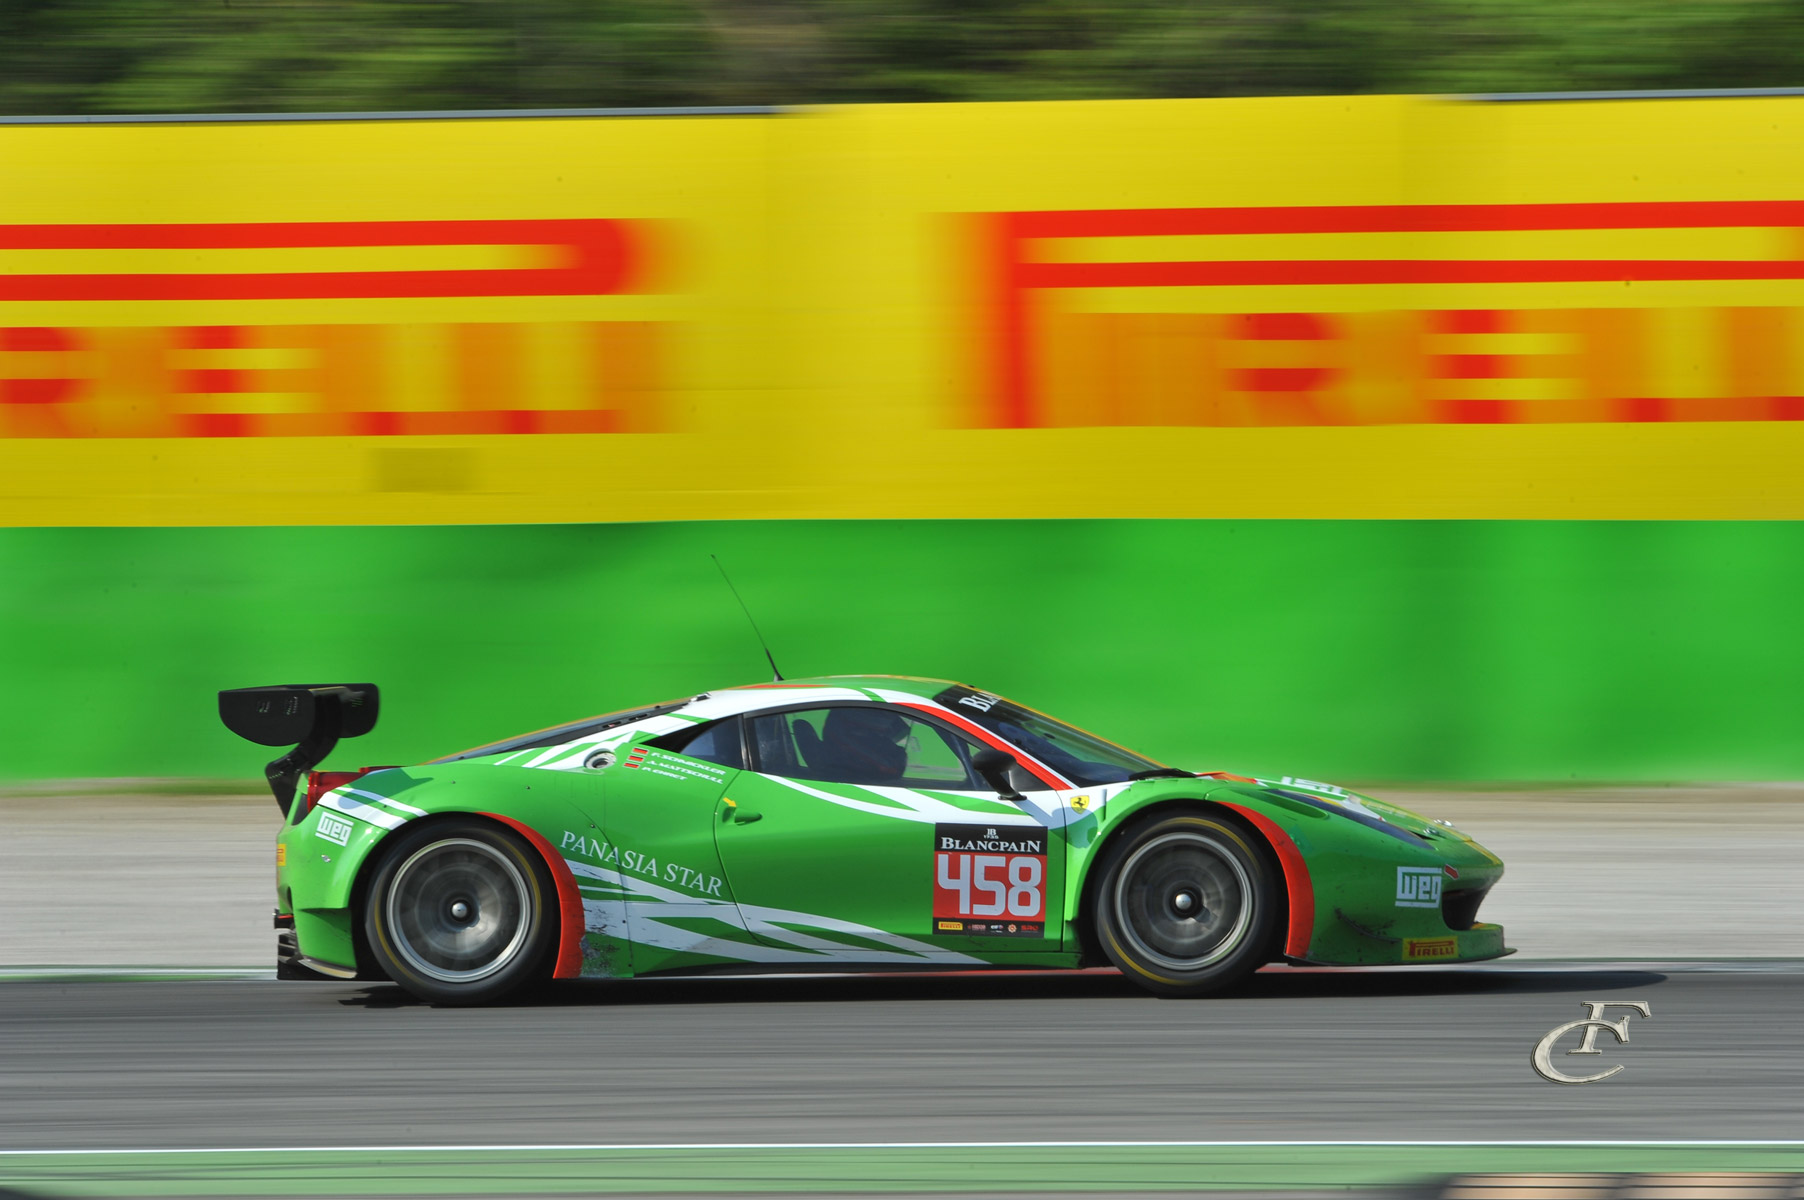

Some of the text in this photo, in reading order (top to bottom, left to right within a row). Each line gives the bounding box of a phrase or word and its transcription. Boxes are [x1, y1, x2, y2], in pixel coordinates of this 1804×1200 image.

[560, 831, 722, 897] PANASIA STAR
[938, 854, 1041, 917] 458
[1408, 940, 1455, 957] PIRELLI
